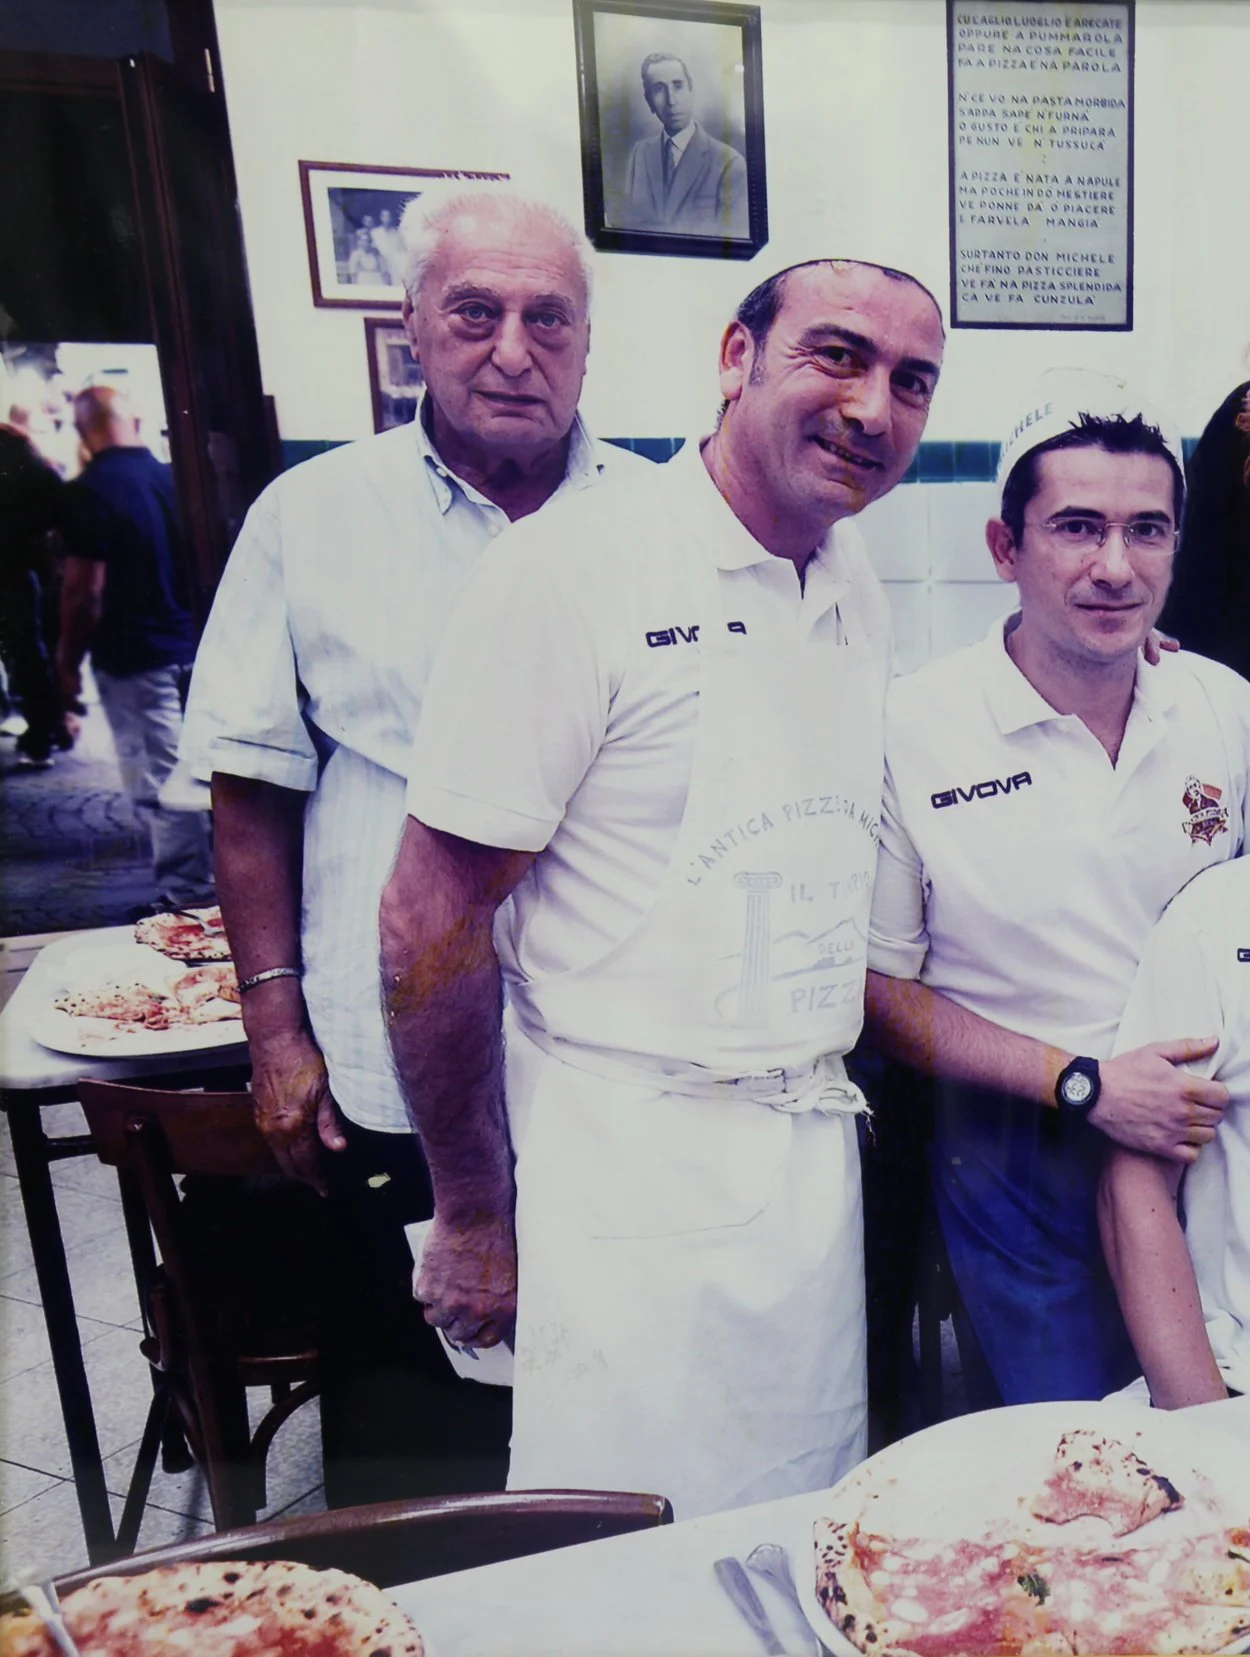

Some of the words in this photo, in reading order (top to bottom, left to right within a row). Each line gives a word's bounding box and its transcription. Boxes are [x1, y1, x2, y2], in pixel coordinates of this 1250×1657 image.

[958, 28, 1008, 40] OPPURE
[1029, 31, 1123, 44] PUMMAROLA
[958, 42, 996, 53] PARE
[1025, 45, 1062, 56] COSA
[1068, 46, 1116, 58] FACILE
[988, 58, 1027, 69] PIZZA
[1062, 60, 1121, 73] PAROLA
[1032, 95, 1073, 107] PASTA
[1075, 96, 1126, 109] MORBIDA
[970, 122, 1008, 133] GUSTO
[1024, 124, 1043, 135] CHI
[1062, 125, 1116, 138] PRIPARA
[976, 135, 1000, 146] NUN
[971, 171, 1007, 183] PIZZA
[1025, 172, 1060, 184] NATA
[1077, 175, 1121, 188] NAPULE
[981, 186, 1020, 197] POCHE
[1056, 189, 1115, 201] MESTIERE
[979, 200, 1019, 211] PONNE
[1063, 203, 1116, 216] PIACERE
[970, 214, 1030, 226] FARVELA
[960, 249, 1021, 260] SURTANTO
[1025, 251, 1049, 262] DON
[1056, 252, 1116, 264] MICHELE
[985, 264, 1011, 275] FINO
[1017, 265, 1101, 278] PASTICCIERE
[1021, 280, 1056, 291] PIZZA
[1059, 281, 1122, 293] SPLENDIDA
[930, 771, 1033, 810] GIVOVA
[790, 882, 814, 904] IL
